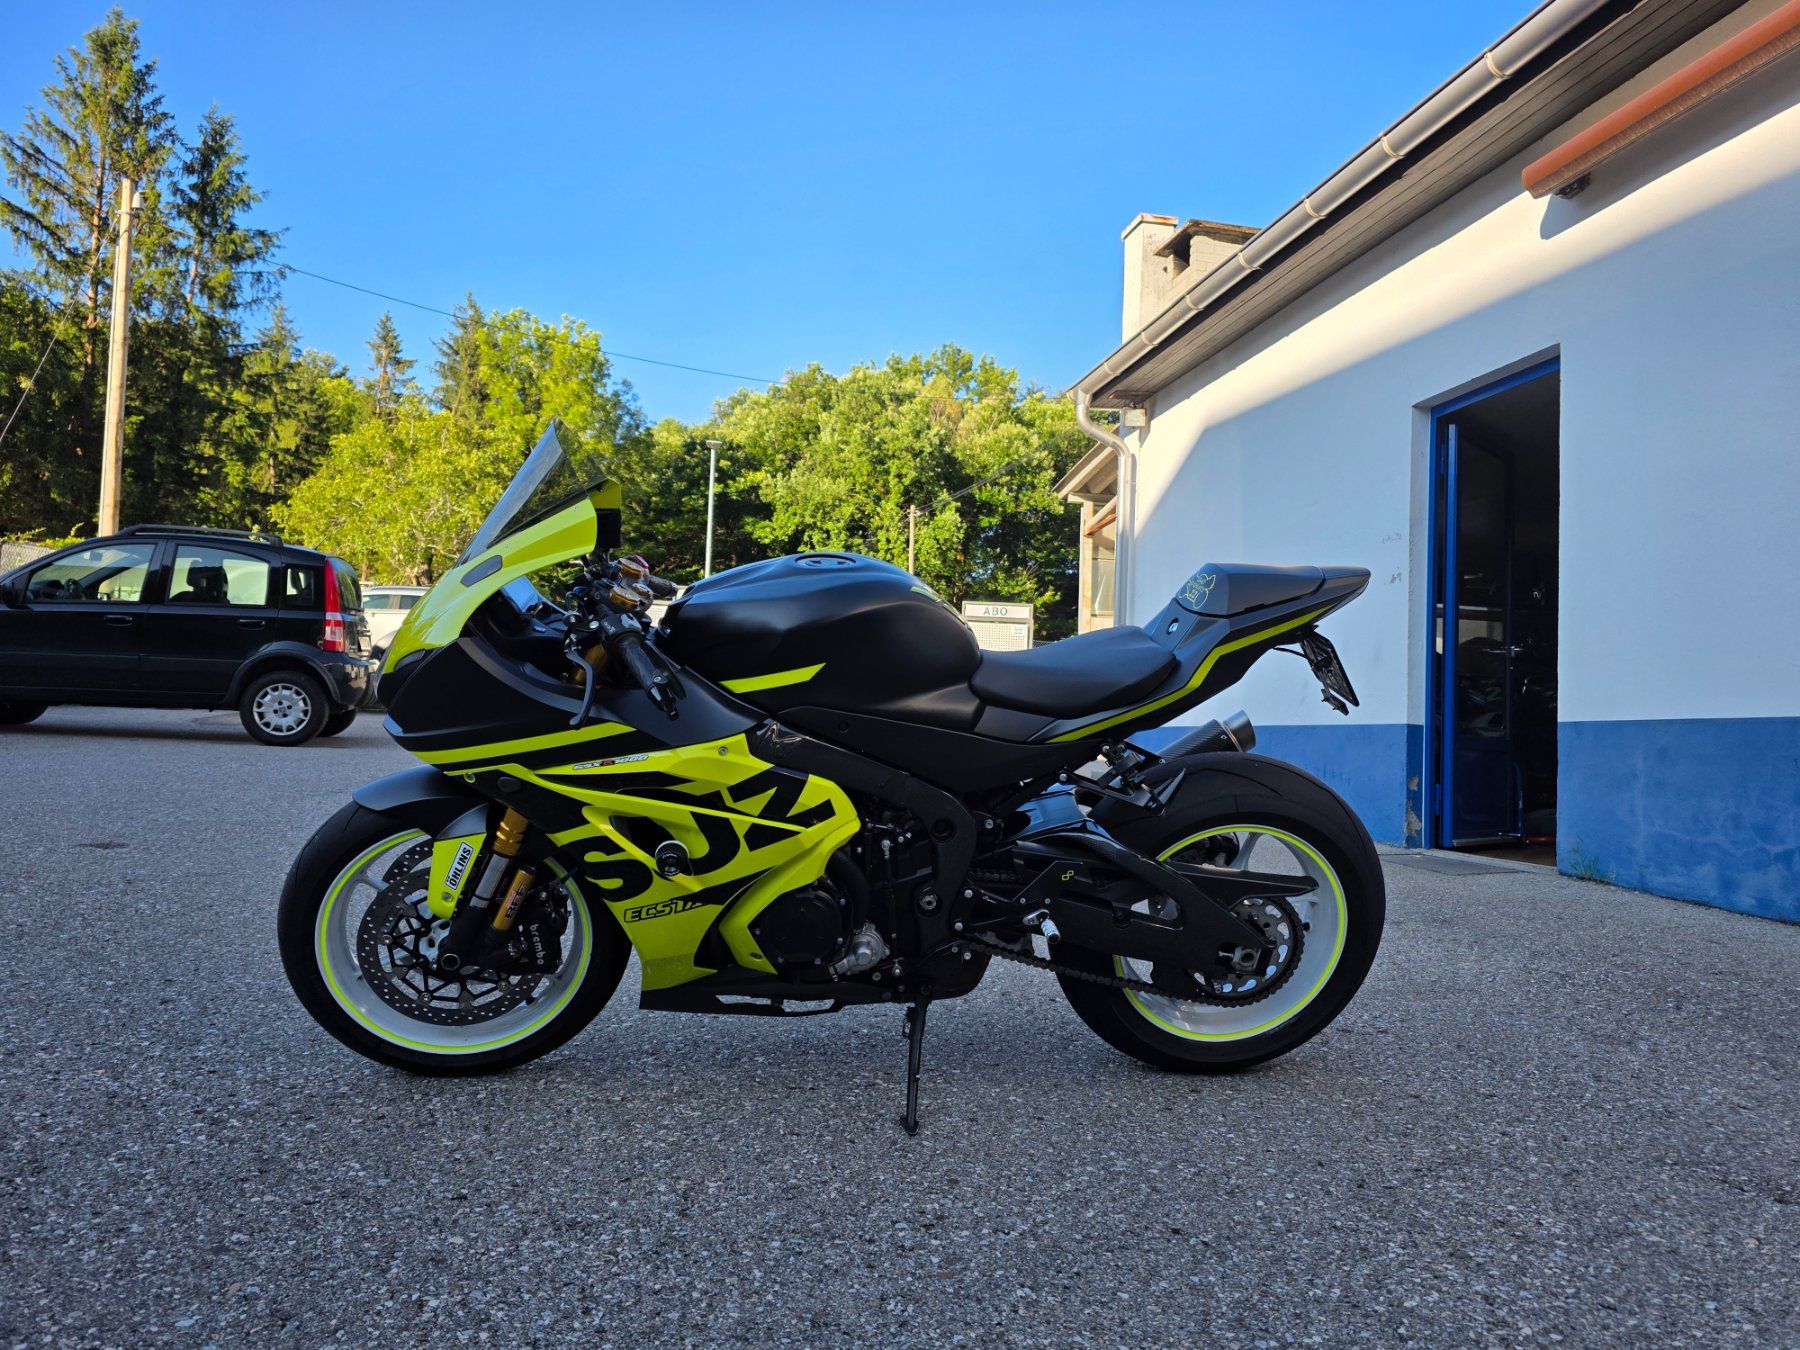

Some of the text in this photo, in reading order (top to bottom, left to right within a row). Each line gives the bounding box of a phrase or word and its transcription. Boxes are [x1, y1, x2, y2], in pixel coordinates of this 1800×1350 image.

[982, 606, 1009, 617] ABO
[446, 846, 472, 887] ÖHLINS
[529, 923, 545, 966] brembo
